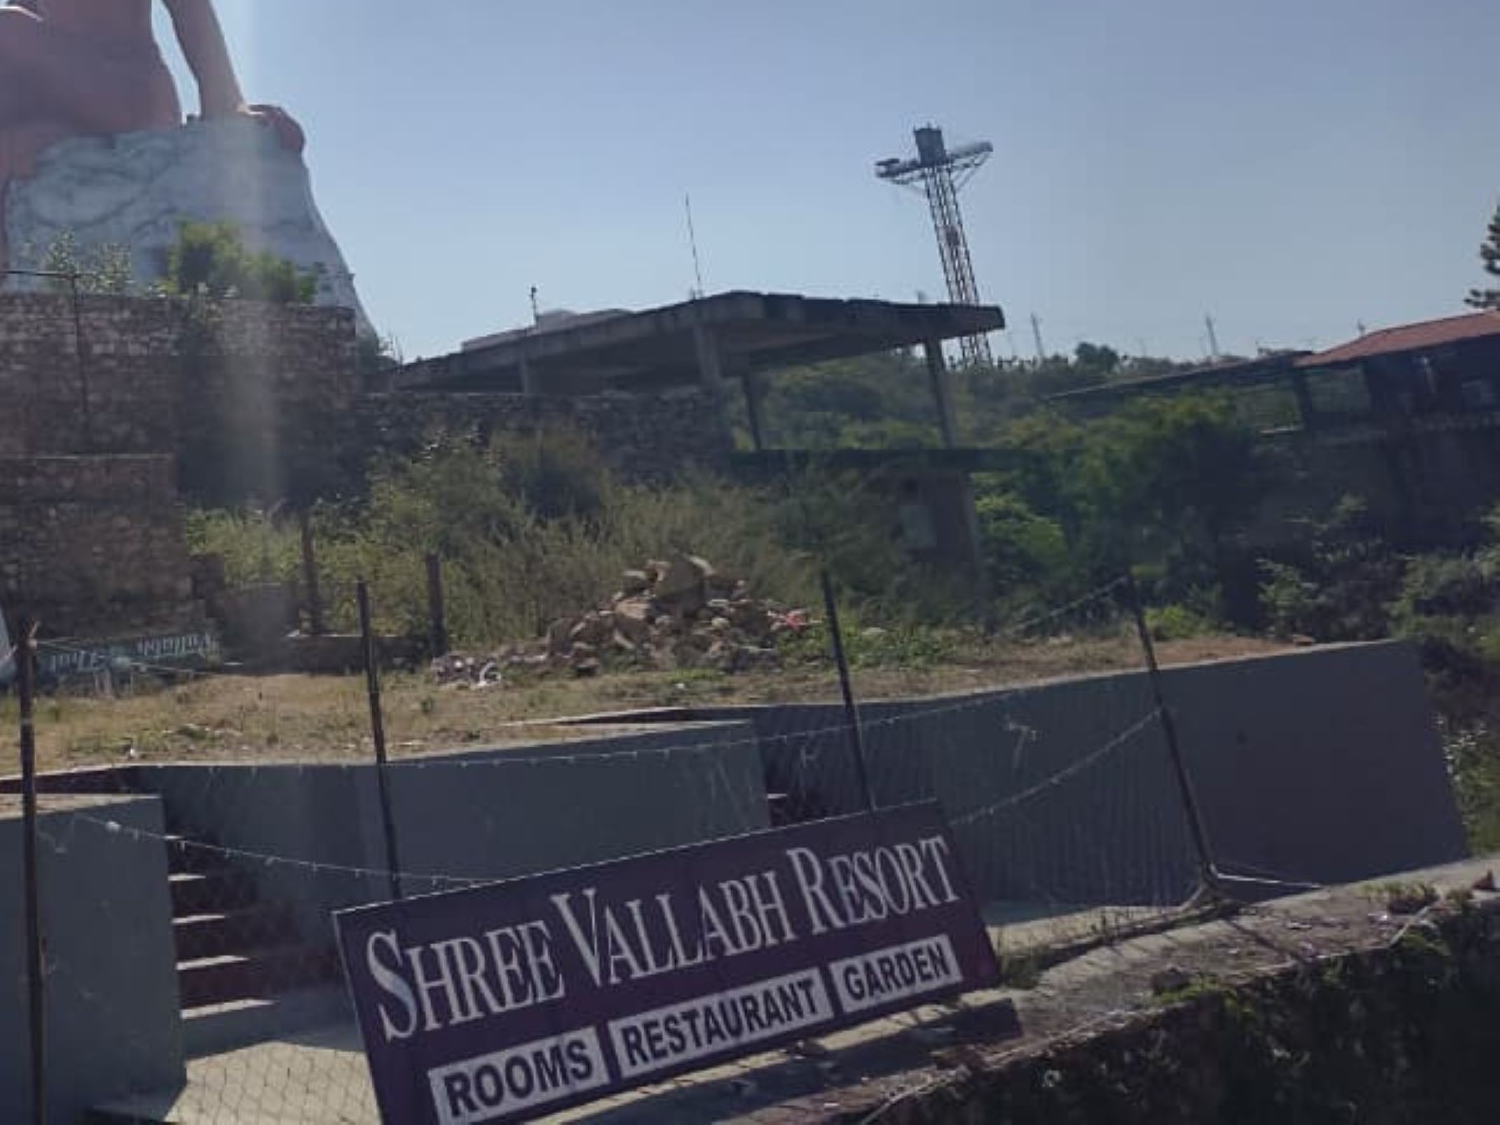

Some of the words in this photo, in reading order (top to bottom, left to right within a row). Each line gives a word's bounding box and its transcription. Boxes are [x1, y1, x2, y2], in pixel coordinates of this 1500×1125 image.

[366, 919, 564, 1041] SHREE
[551, 870, 784, 987] VALLABH
[787, 835, 960, 935] RESORT
[443, 1037, 594, 1119] ROOMS
[621, 978, 819, 1068] RESTAURANT
[844, 944, 950, 1002] GARDEN
